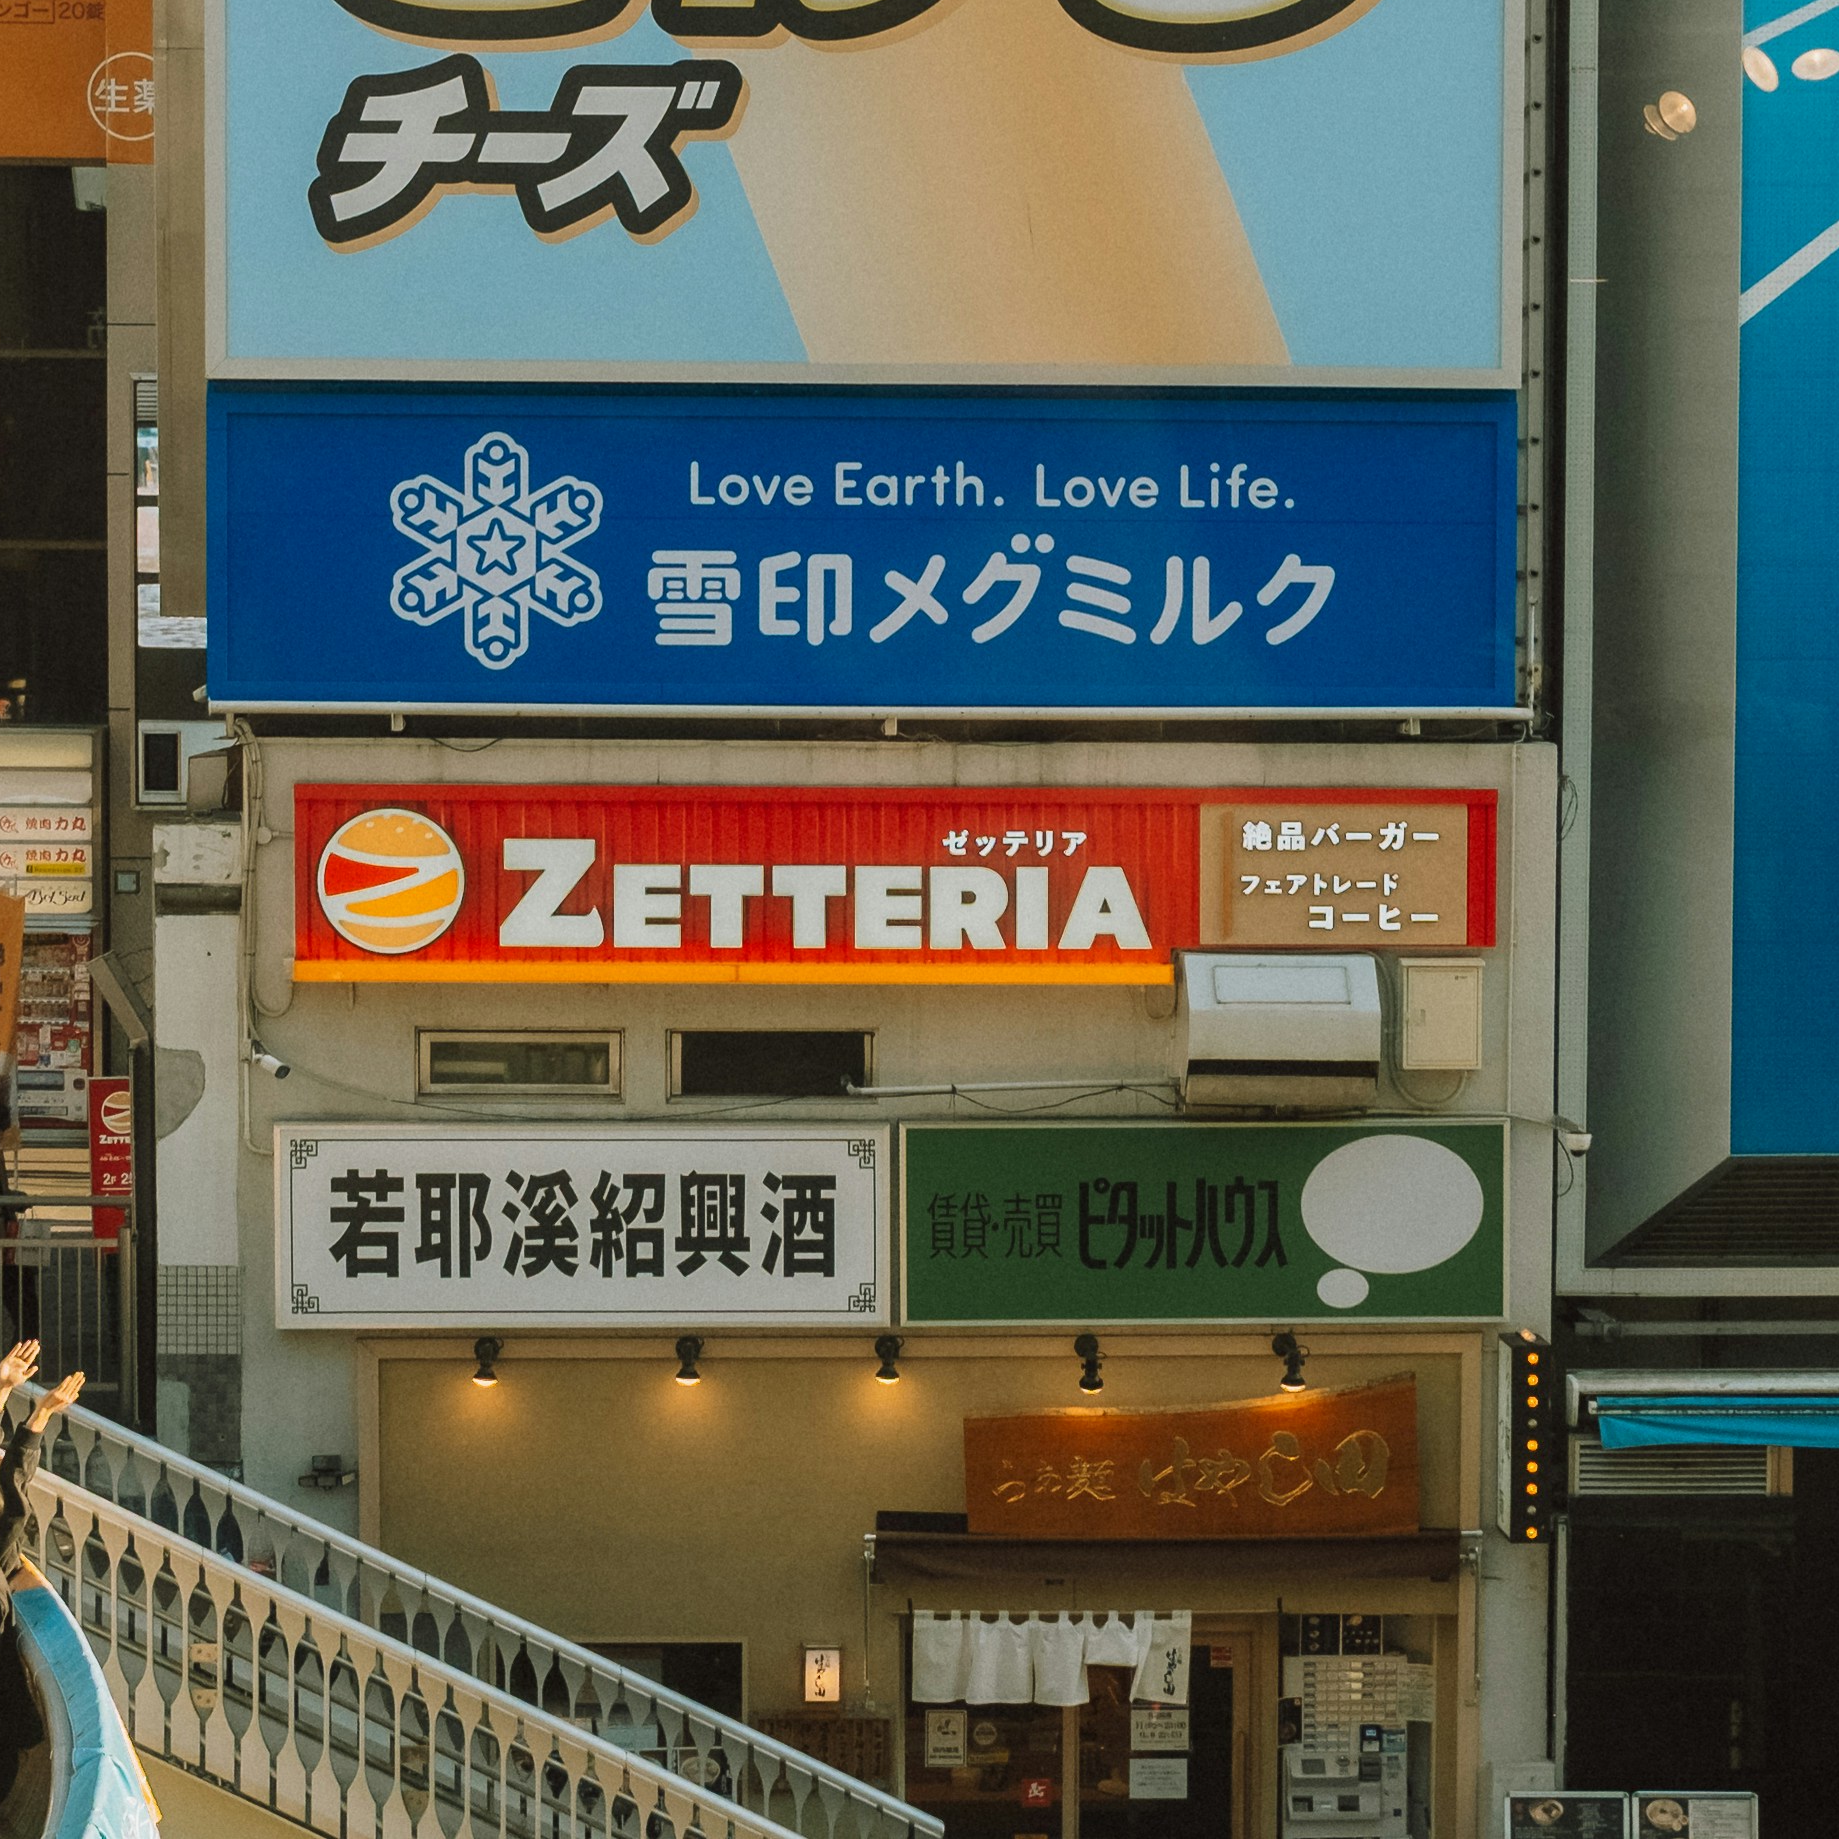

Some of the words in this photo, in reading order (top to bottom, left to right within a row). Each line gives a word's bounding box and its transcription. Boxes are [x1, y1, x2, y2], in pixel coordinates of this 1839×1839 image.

[318, 64, 731, 233] チーズ
[689, 460, 813, 507] Love
[835, 461, 1004, 507] Earth.
[1034, 462, 1159, 508] Love
[1178, 462, 1296, 508] Life.
[647, 533, 1336, 646] 雪印メグミルク
[942, 830, 1087, 857] ゼッテリア
[1242, 820, 1440, 851] 絶品バーガー
[499, 837, 1153, 950] ZETTERIA
[1240, 873, 1399, 897] フェアトレード
[1307, 904, 1440, 931] コーヒー
[927, 1189, 1062, 1261] 賃貸・売買
[1076, 1176, 1290, 1273] ピタットハウス
